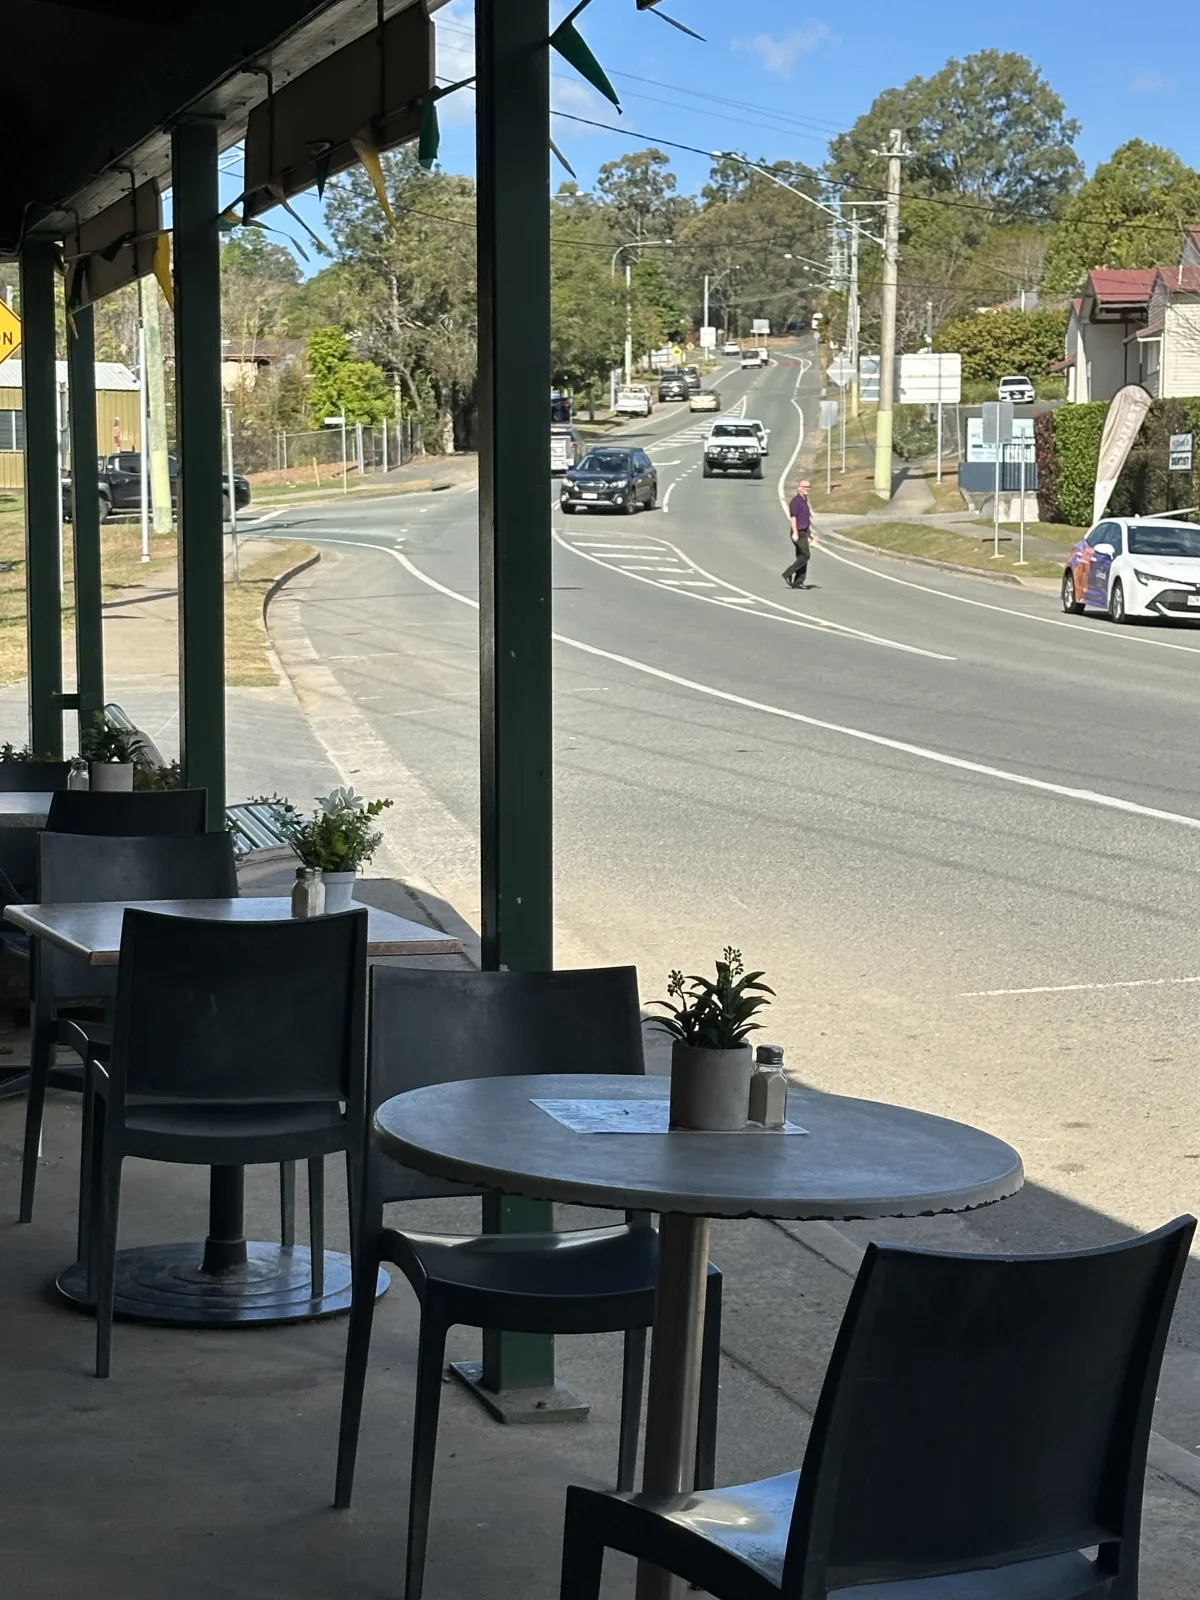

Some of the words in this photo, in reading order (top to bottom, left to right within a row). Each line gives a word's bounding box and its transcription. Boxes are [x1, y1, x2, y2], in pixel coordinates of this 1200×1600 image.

[0, 331, 13, 346] N
[1108, 402, 1142, 466] DENTIST
[1171, 456, 1189, 466] DENTIST
